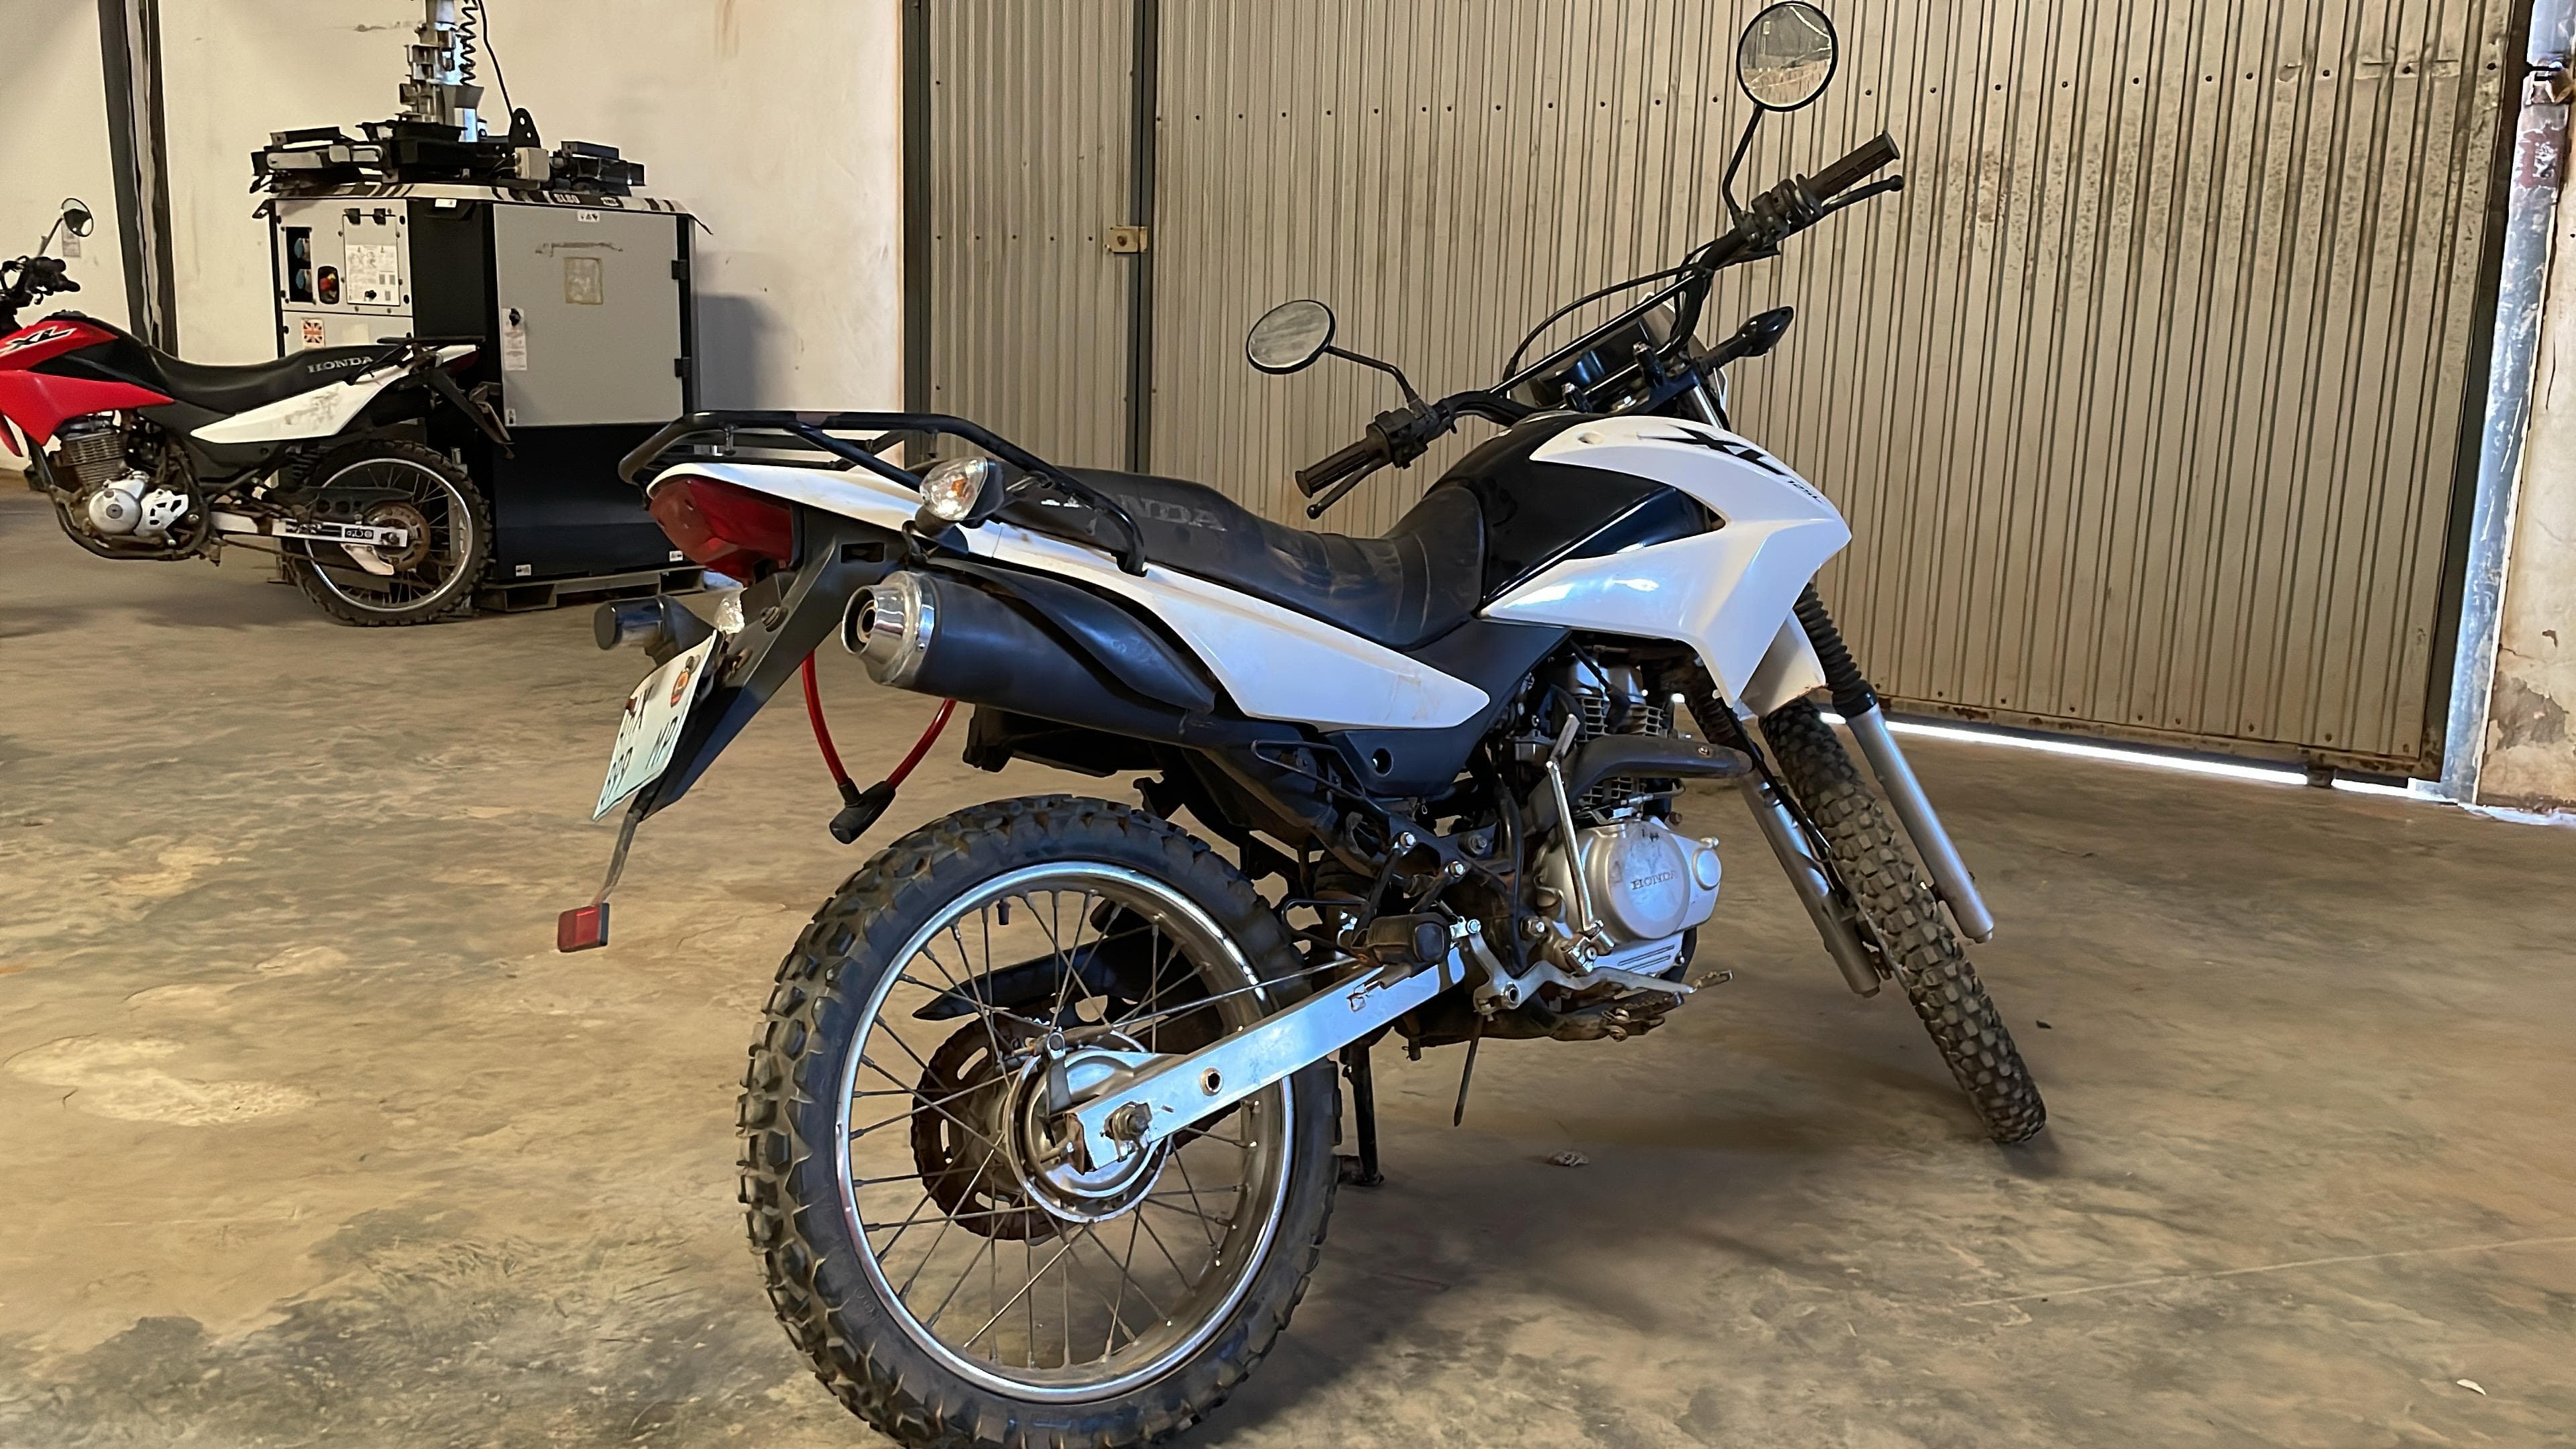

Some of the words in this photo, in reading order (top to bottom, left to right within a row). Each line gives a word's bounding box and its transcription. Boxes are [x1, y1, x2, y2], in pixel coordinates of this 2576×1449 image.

[308, 356, 373, 373] HONDA
[1648, 424, 1786, 475] XL
[1630, 870, 1677, 890] HONDA
